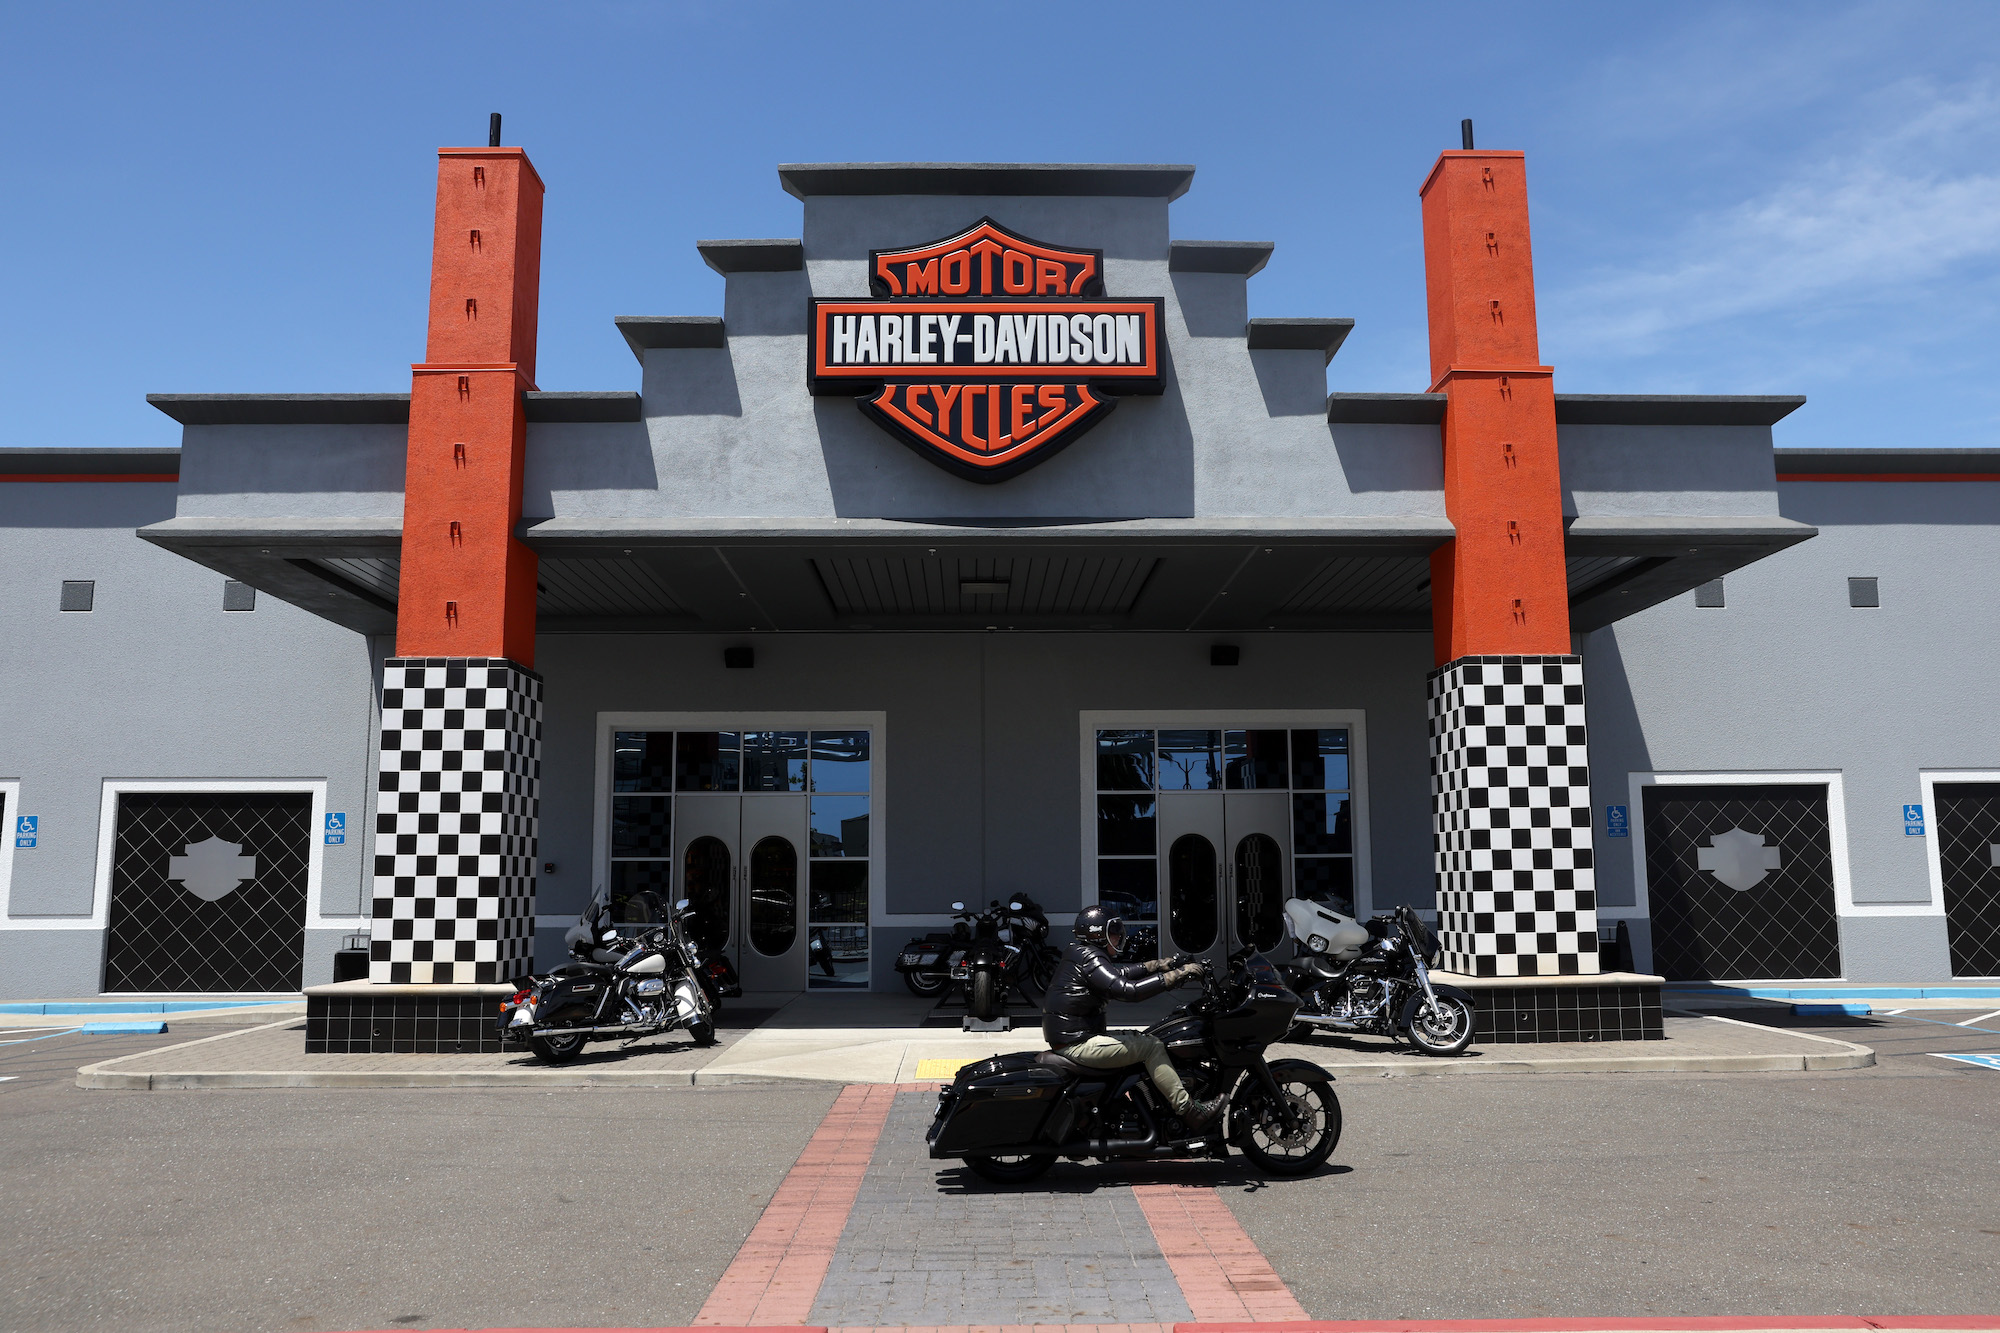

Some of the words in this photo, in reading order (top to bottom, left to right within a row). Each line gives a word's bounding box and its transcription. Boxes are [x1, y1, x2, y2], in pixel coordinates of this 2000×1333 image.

[906, 238, 1068, 295] MOTOR
[832, 314, 1141, 364] HARLEY-DAVIDSON
[906, 384, 1067, 452] CYCLES
